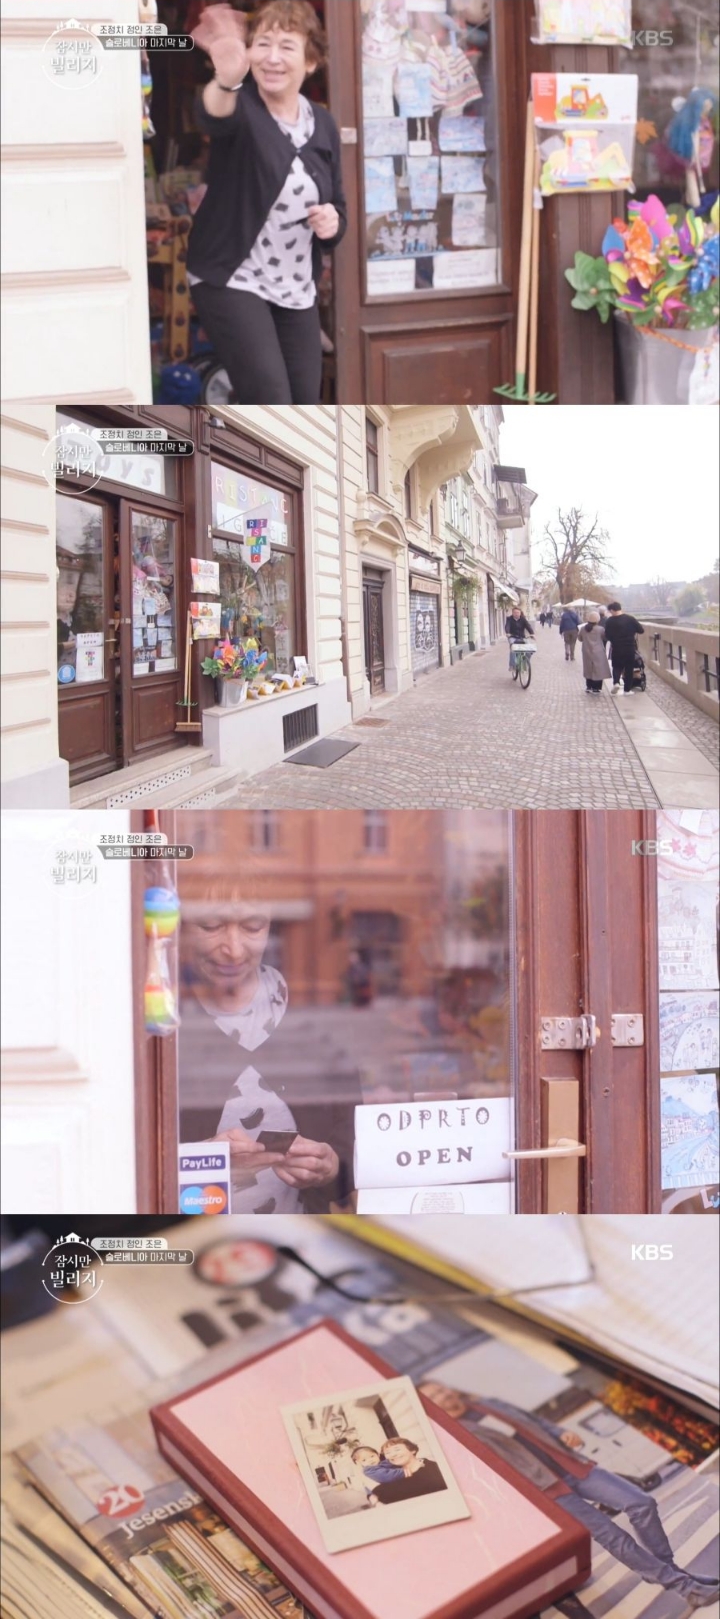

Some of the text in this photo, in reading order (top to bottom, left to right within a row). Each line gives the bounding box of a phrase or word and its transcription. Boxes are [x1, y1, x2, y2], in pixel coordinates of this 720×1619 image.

[376, 1106, 490, 1132] ODPRTO
[182, 1157, 222, 1170] PayLife
[396, 1146, 474, 1167] OPEN
[184, 1195, 223, 1206] Maestro
